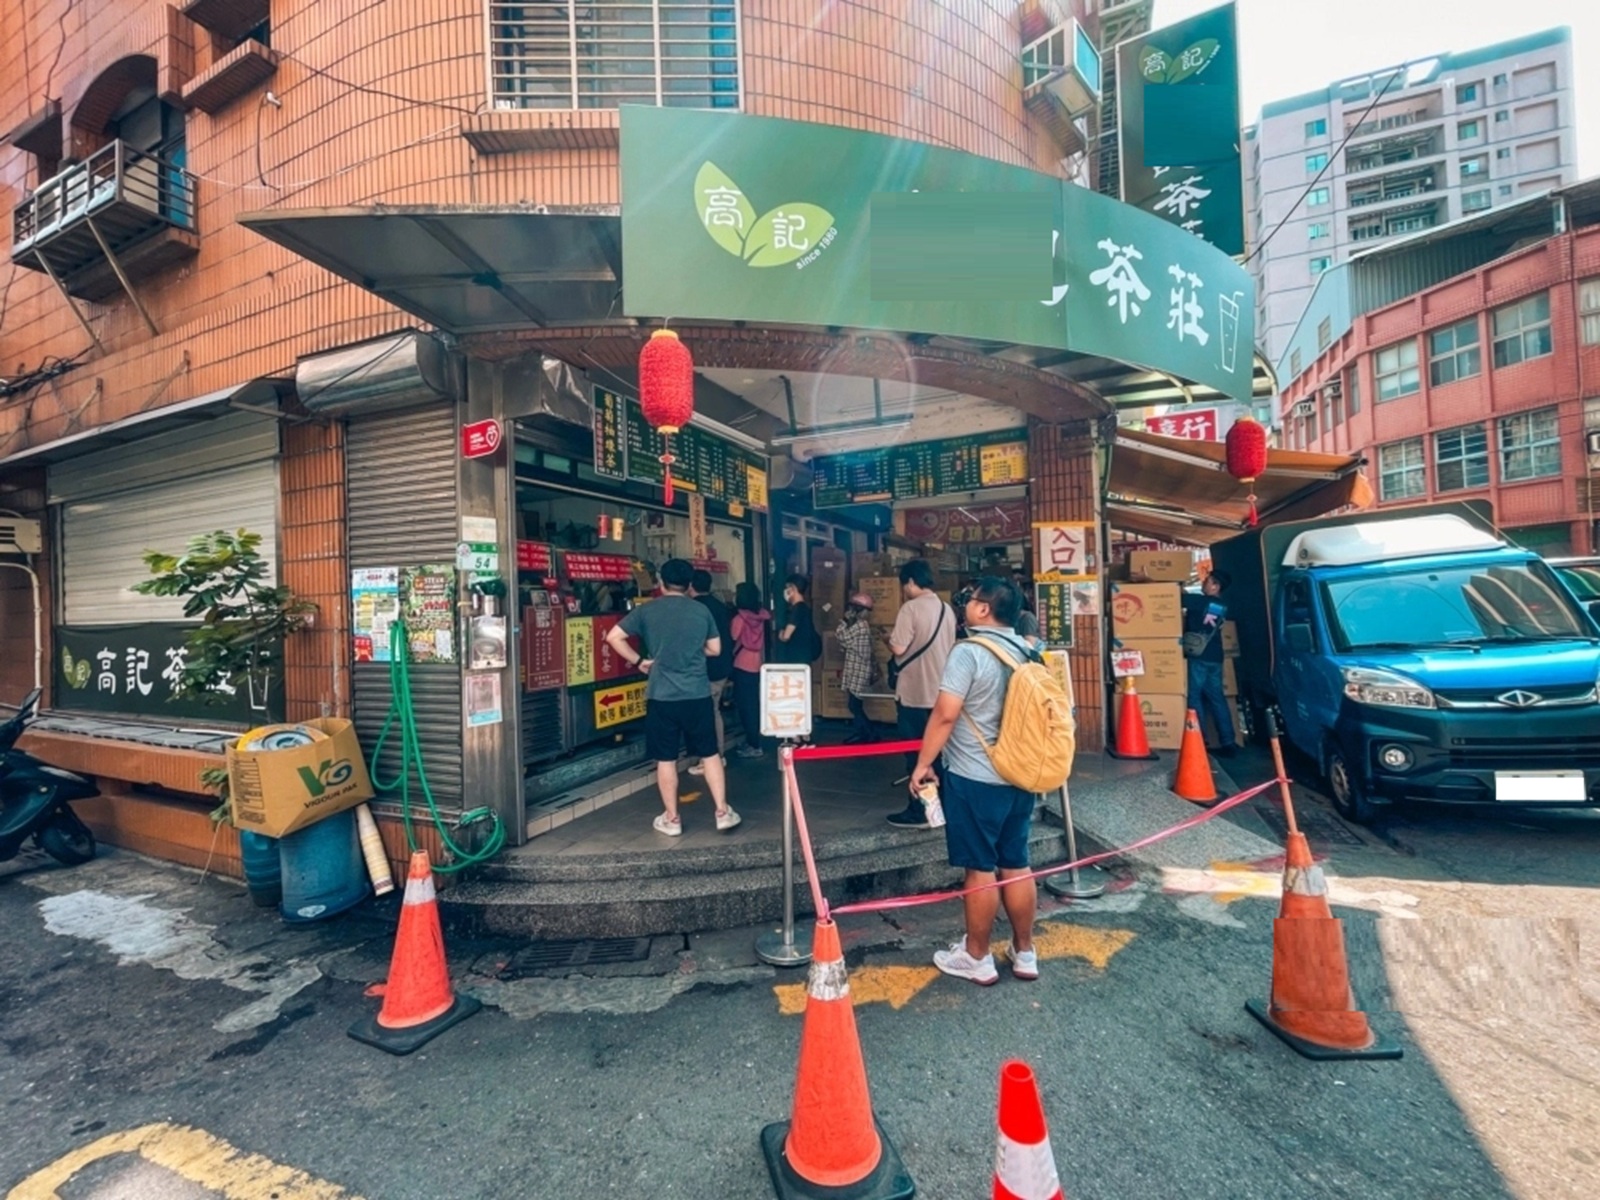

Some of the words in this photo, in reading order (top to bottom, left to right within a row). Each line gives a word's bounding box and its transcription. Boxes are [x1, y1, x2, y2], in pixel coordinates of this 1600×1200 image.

[703, 186, 809, 250] 高記
[795, 249, 821, 270] since
[819, 227, 838, 250] 1980
[475, 557, 490, 569] 54
[1051, 527, 1081, 565] 入口
[768, 675, 805, 730] 出口
